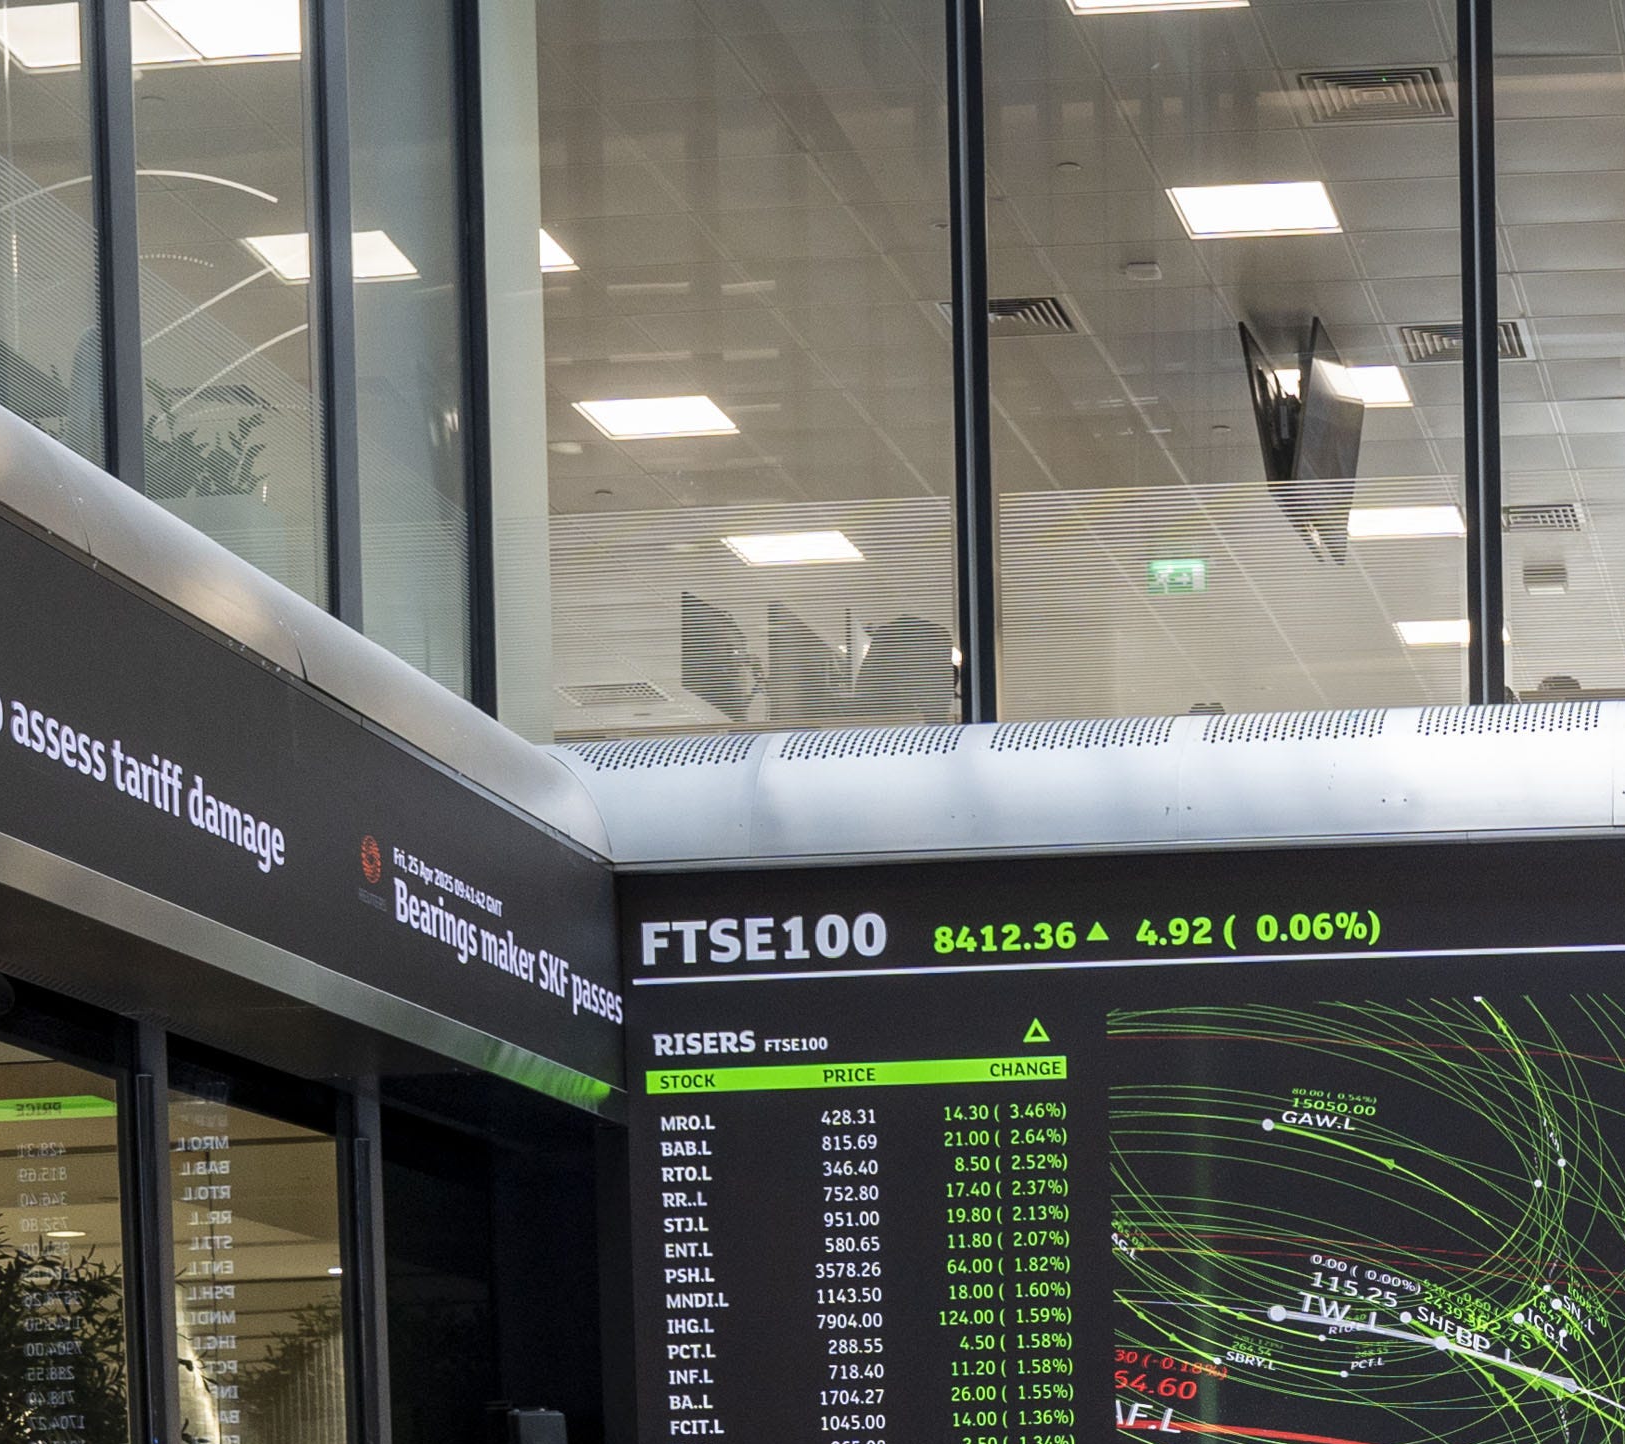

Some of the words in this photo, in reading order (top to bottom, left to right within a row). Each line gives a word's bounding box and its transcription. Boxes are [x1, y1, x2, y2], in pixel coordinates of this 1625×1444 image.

[10, 701, 106, 781] assess
[111, 740, 183, 817] tariff
[188, 775, 285, 873] damage
[642, 912, 886, 965] FTSE100
[934, 922, 1076, 953] 8412.36
[393, 877, 478, 964] Bearings
[480, 929, 535, 983] maker
[539, 949, 569, 998] SKF
[571, 973, 623, 1024] passes
[653, 1030, 756, 1056] RISERS
[764, 1037, 828, 1052] FTSE100
[661, 1075, 714, 1088] STOCK
[824, 1069, 874, 1082] PRICE
[991, 1062, 1059, 1076] CHANGE
[1291, 1097, 1376, 1117] 15050.00
[661, 1115, 715, 1131] MRO.L
[821, 1109, 876, 1125] 428.31
[1281, 1111, 1356, 1131] GAW.L
[660, 1140, 712, 1157] BAB.L
[822, 1134, 877, 1151] 815.69
[661, 1166, 712, 1182] RTO.L
[823, 1160, 878, 1176] 346.40
[664, 1217, 709, 1233] STJ.L
[824, 1211, 879, 1227] 951.00
[664, 1267, 715, 1283] PSH.L
[816, 1262, 881, 1278] 3578.26
[669, 1394, 713, 1410] BA..L
[820, 1389, 884, 1405] 1704.27
